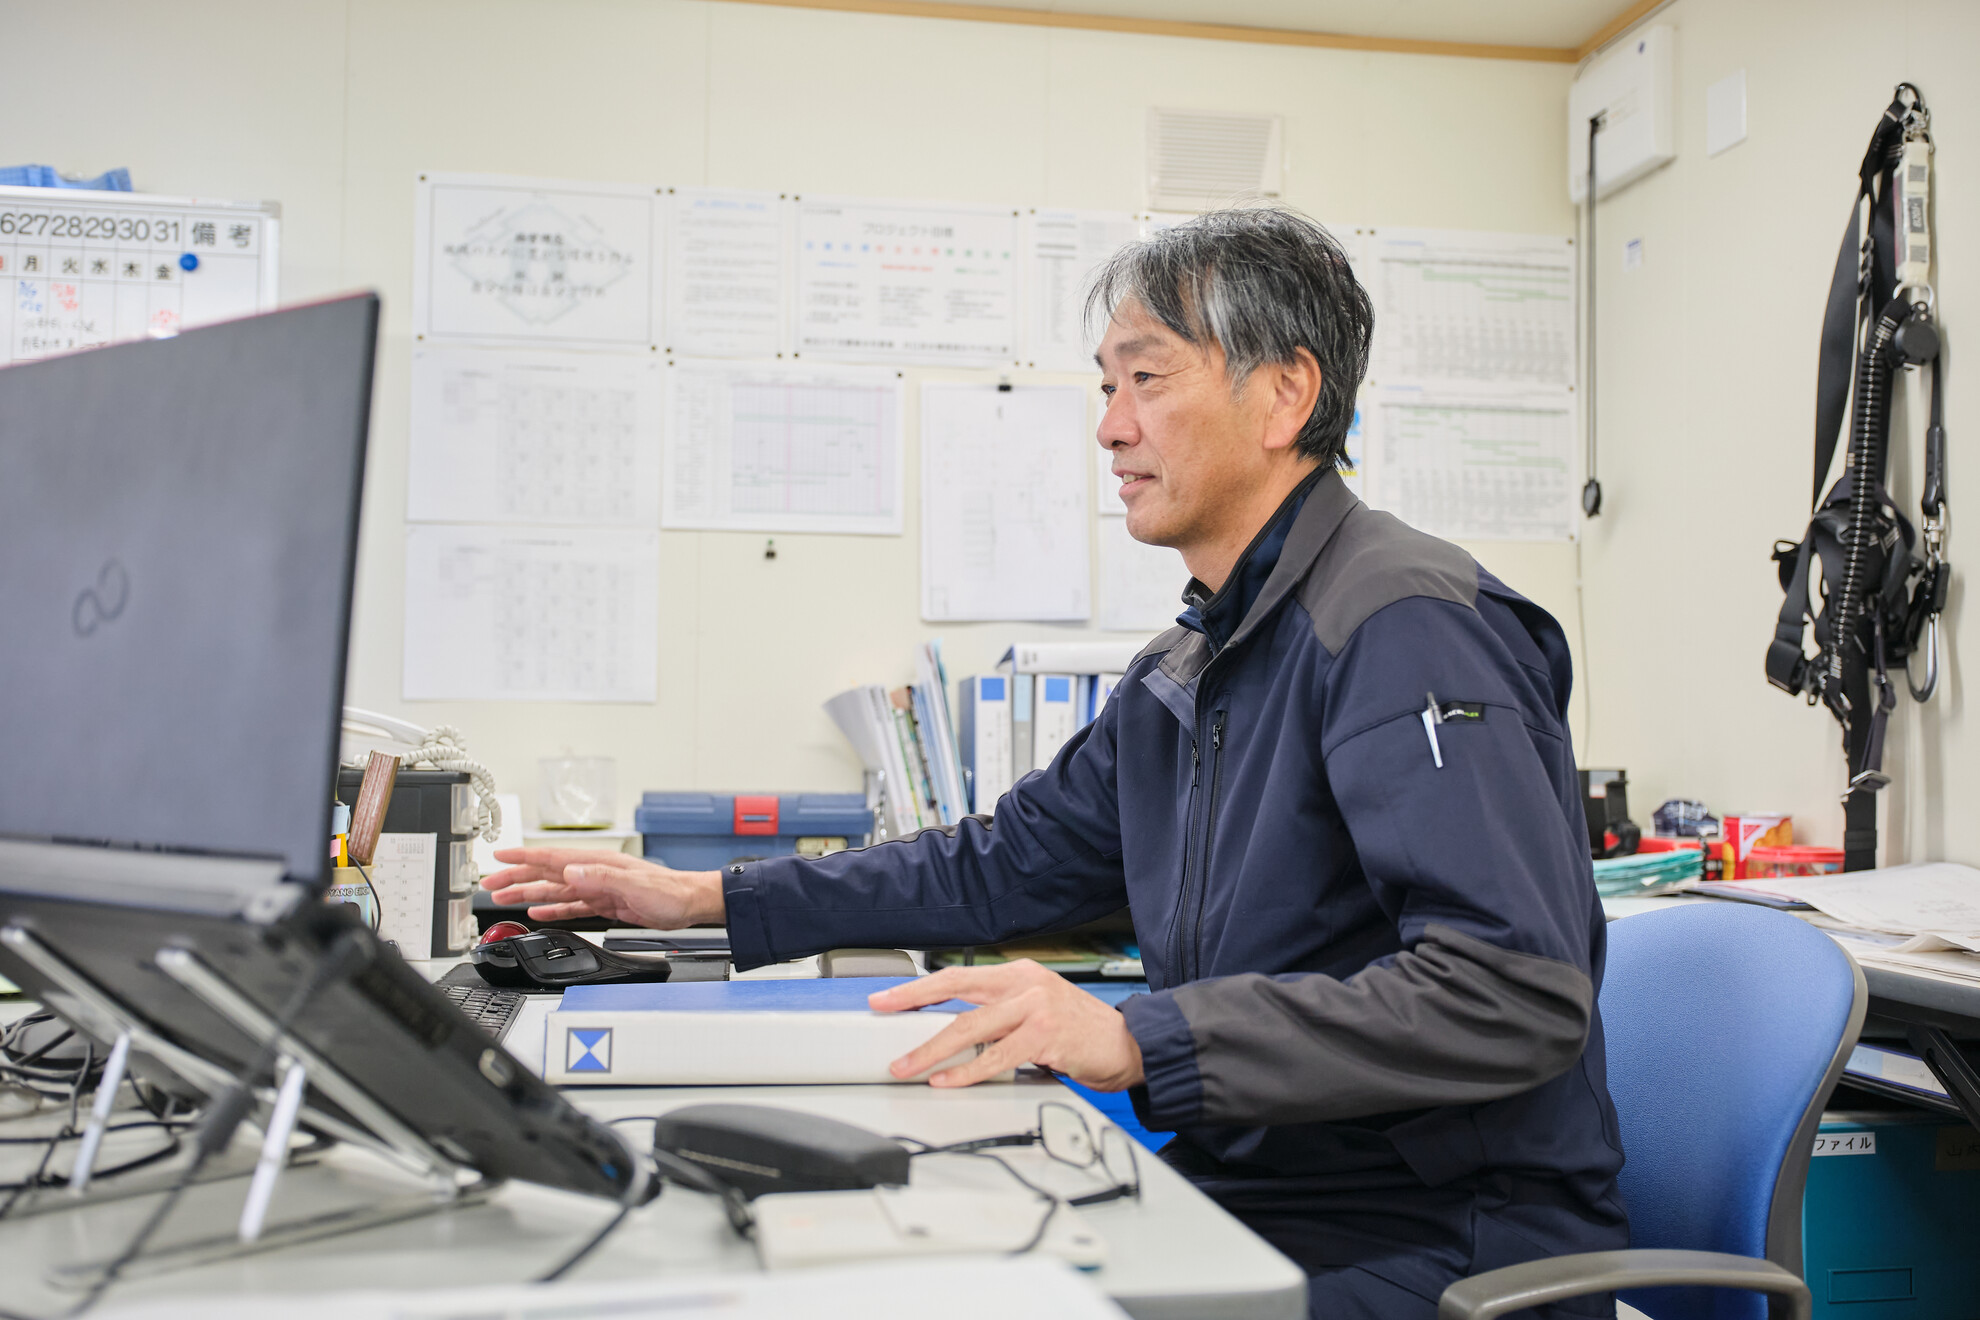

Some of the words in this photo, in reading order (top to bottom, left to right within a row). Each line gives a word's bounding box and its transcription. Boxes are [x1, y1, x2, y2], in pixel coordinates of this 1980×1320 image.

[18, 213, 49, 236] 27
[51, 215, 83, 238] 28
[84, 217, 116, 240] 29
[118, 218, 150, 242] 30
[154, 220, 180, 242] 31
[24, 255, 37, 271] 月
[63, 256, 79, 274] 火
[92, 258, 109, 274] 水
[123, 261, 141, 277] 木
[156, 264, 172, 280] 金
